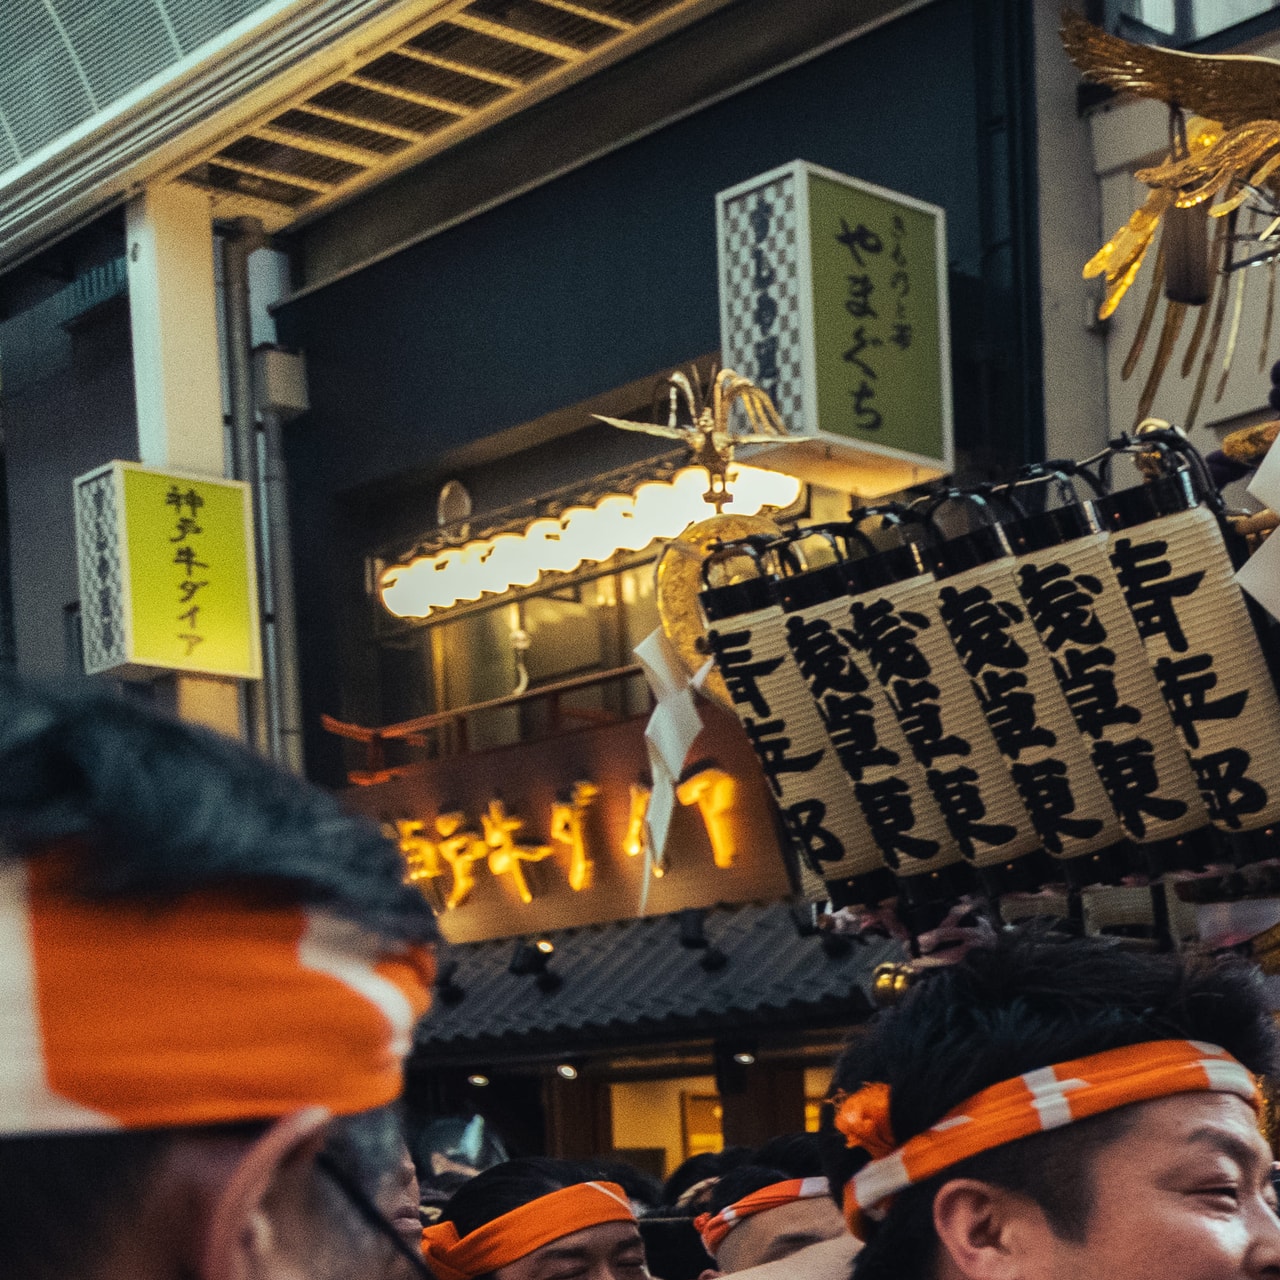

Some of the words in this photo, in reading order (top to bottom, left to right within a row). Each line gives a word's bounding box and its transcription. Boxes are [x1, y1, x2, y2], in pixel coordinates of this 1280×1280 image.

[165, 485, 209, 657] 神戸牛ダイア
